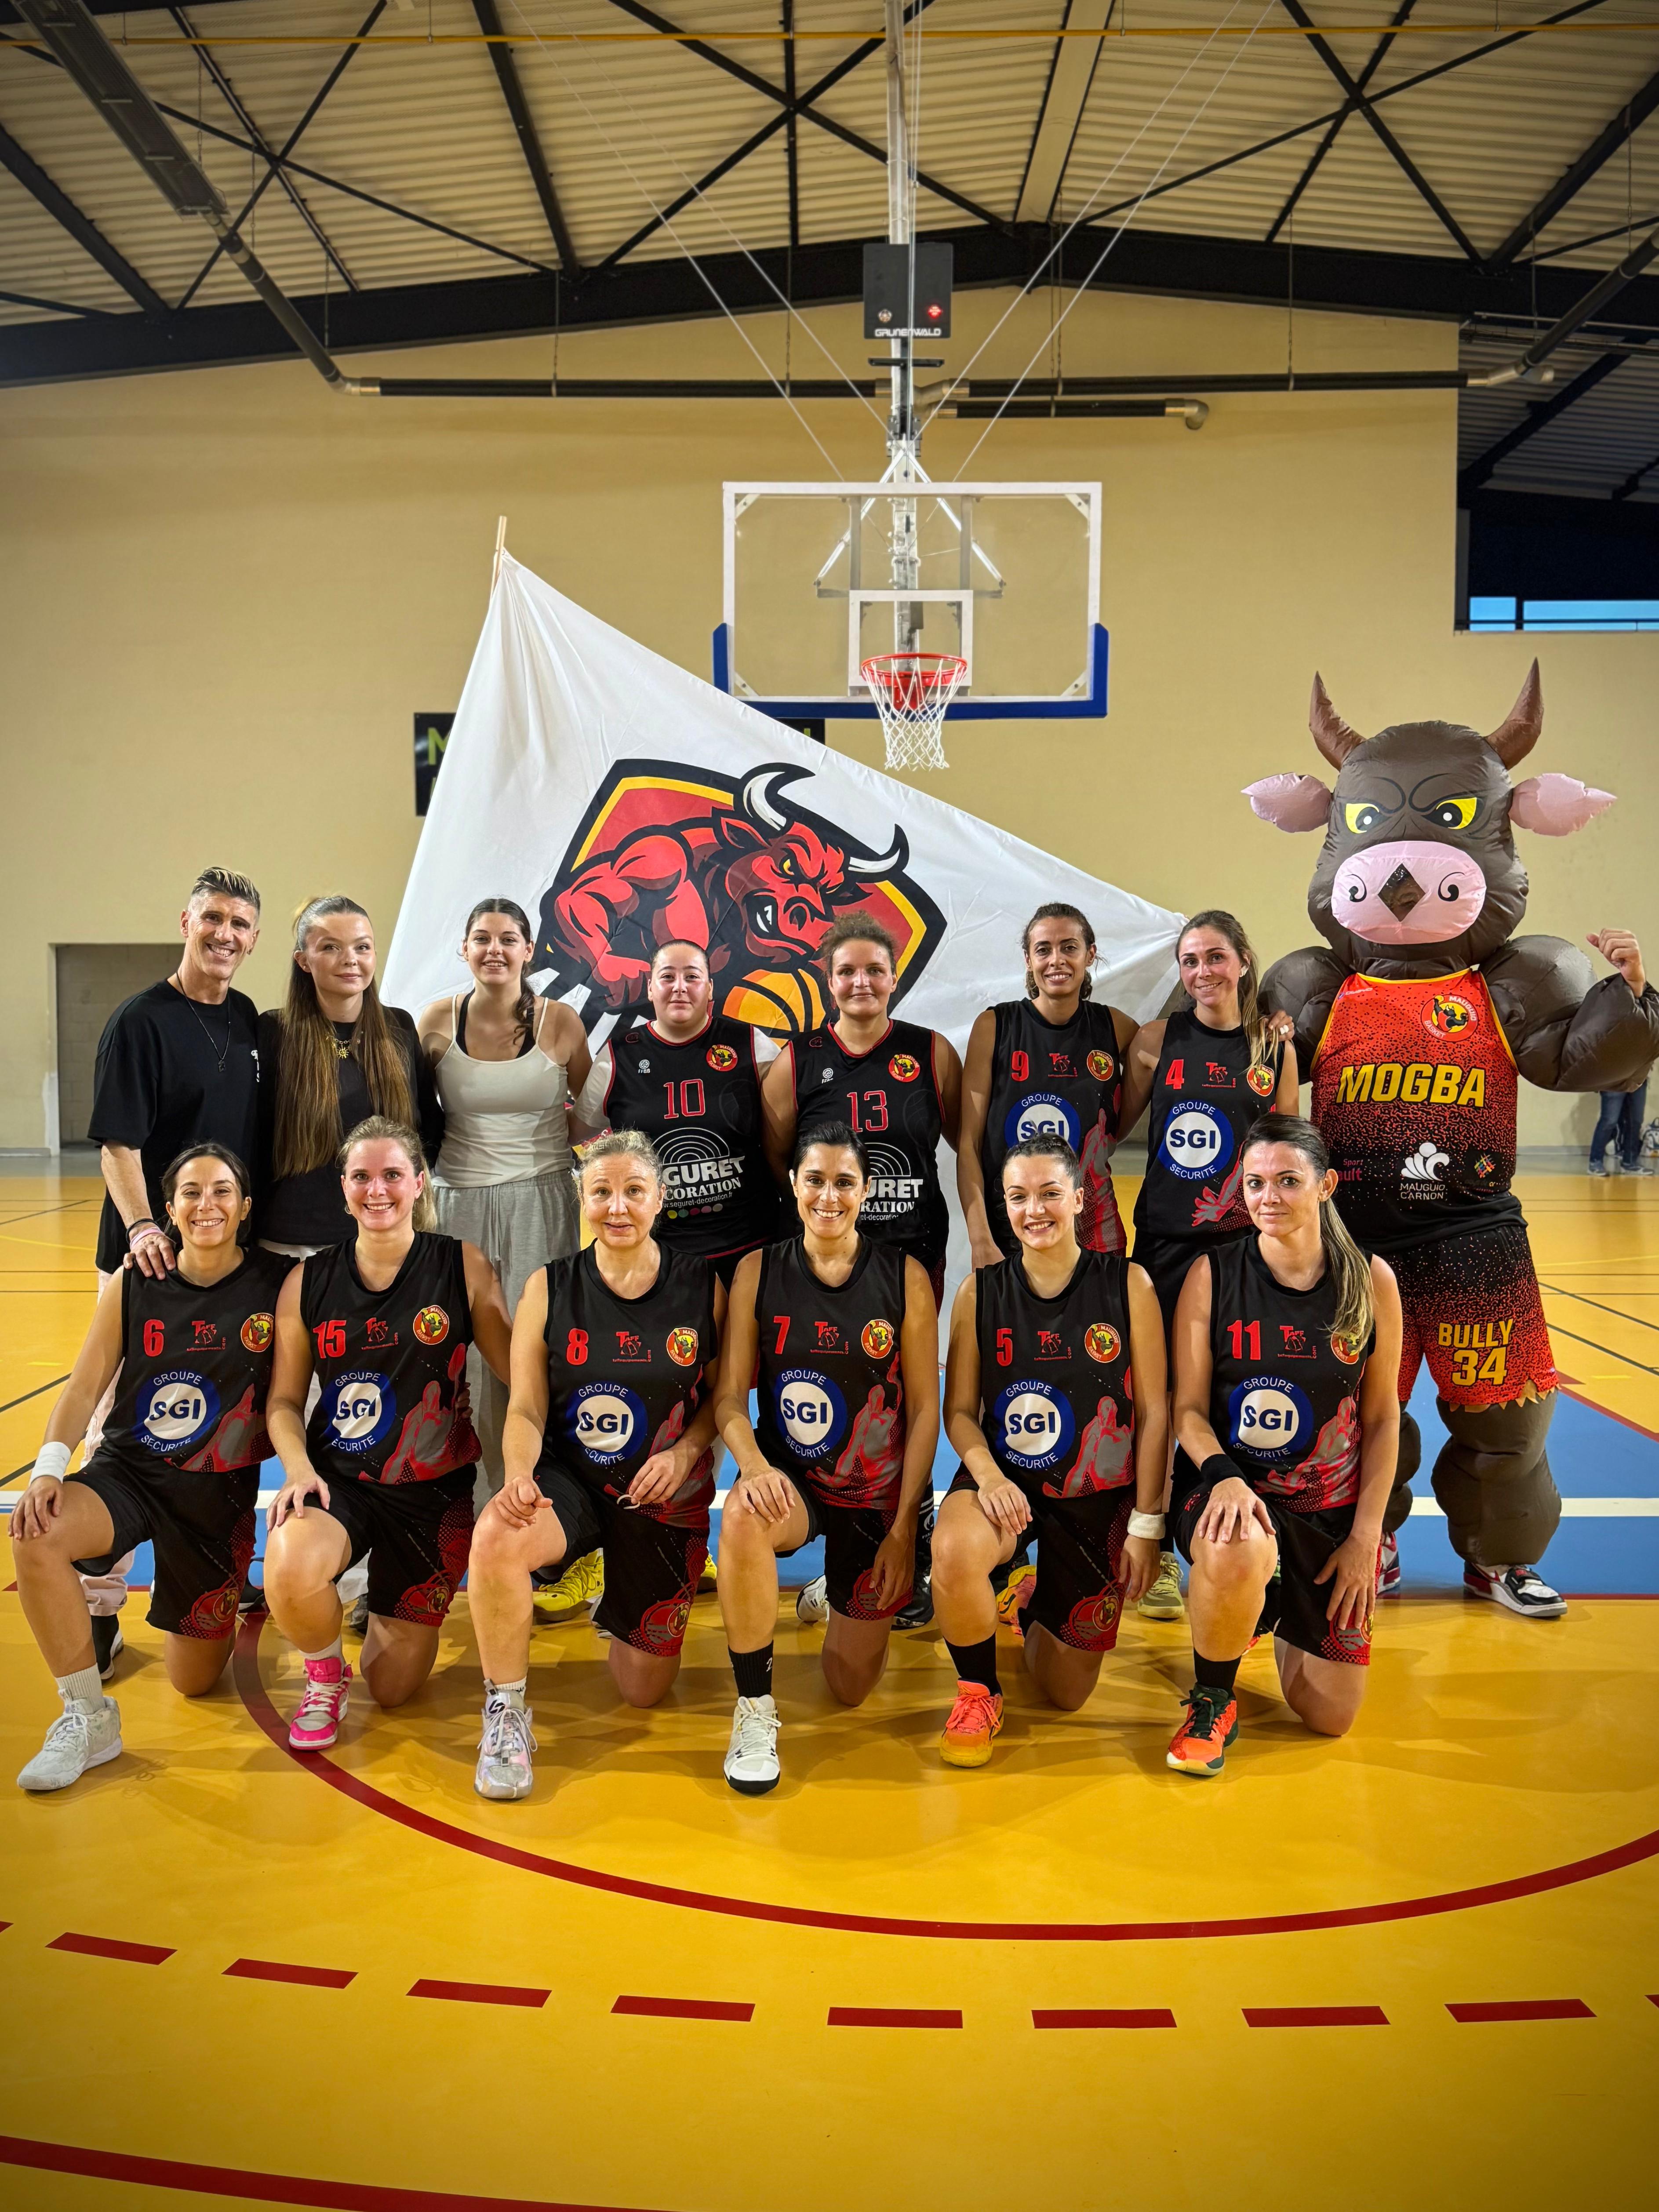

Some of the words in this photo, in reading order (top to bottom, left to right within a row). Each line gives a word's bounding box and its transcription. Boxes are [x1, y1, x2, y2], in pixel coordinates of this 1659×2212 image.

[875, 328, 942, 337] GRUNENWALD
[1449, 995, 1476, 1022] MAUGUIO
[1424, 1020, 1446, 1039] BASKET
[1011, 1050, 1029, 1081] 9
[1165, 1059, 1184, 1090] 4
[1335, 1063, 1486, 1107] MOGBA
[663, 1078, 706, 1119] 10
[1022, 1093, 1062, 1107] GROUPE
[1172, 1102, 1215, 1115] GROUPE
[847, 1090, 889, 1132] 13
[1021, 1121, 1064, 1140] SGI
[1170, 1128, 1216, 1149] SGI
[662, 1156, 745, 1186] GURET
[1170, 1164, 1217, 1180] SECURITE
[664, 1177, 741, 1201] CORATION
[867, 1179, 923, 1198] URET
[1400, 1182, 1445, 1192] MAUGUIO
[1401, 1192, 1444, 1200] CARNON
[860, 1201, 915, 1213] RATION
[143, 1319, 164, 1357] 6
[313, 1320, 347, 1359] 15
[773, 1316, 790, 1354] 7
[1227, 1320, 1261, 1361] 11
[1438, 1319, 1513, 1348] BULLY
[566, 1328, 589, 1365] 8
[997, 1328, 1013, 1366] 5
[1452, 1347, 1507, 1386] 34
[153, 1372, 202, 1386] GROUPE
[335, 1372, 381, 1387] GROUPE
[781, 1370, 826, 1386] GROUPE
[1006, 1381, 1052, 1397] GROUPE
[1243, 1377, 1294, 1393] GROUPE
[578, 1383, 628, 1397] GROUPE
[149, 1399, 201, 1421] SGI
[336, 1398, 377, 1421] SGI
[783, 1398, 827, 1424] SGI
[1243, 1405, 1293, 1431] SGI
[579, 1412, 629, 1435] SGI
[1008, 1412, 1055, 1434] SGI
[331, 1435, 376, 1452] ECURITE
[786, 1435, 830, 1458] SECURITE
[1233, 1442, 1291, 1458] SECURITE
[585, 1447, 625, 1465] ECURITE
[1006, 1451, 1059, 1469] SECURITE
